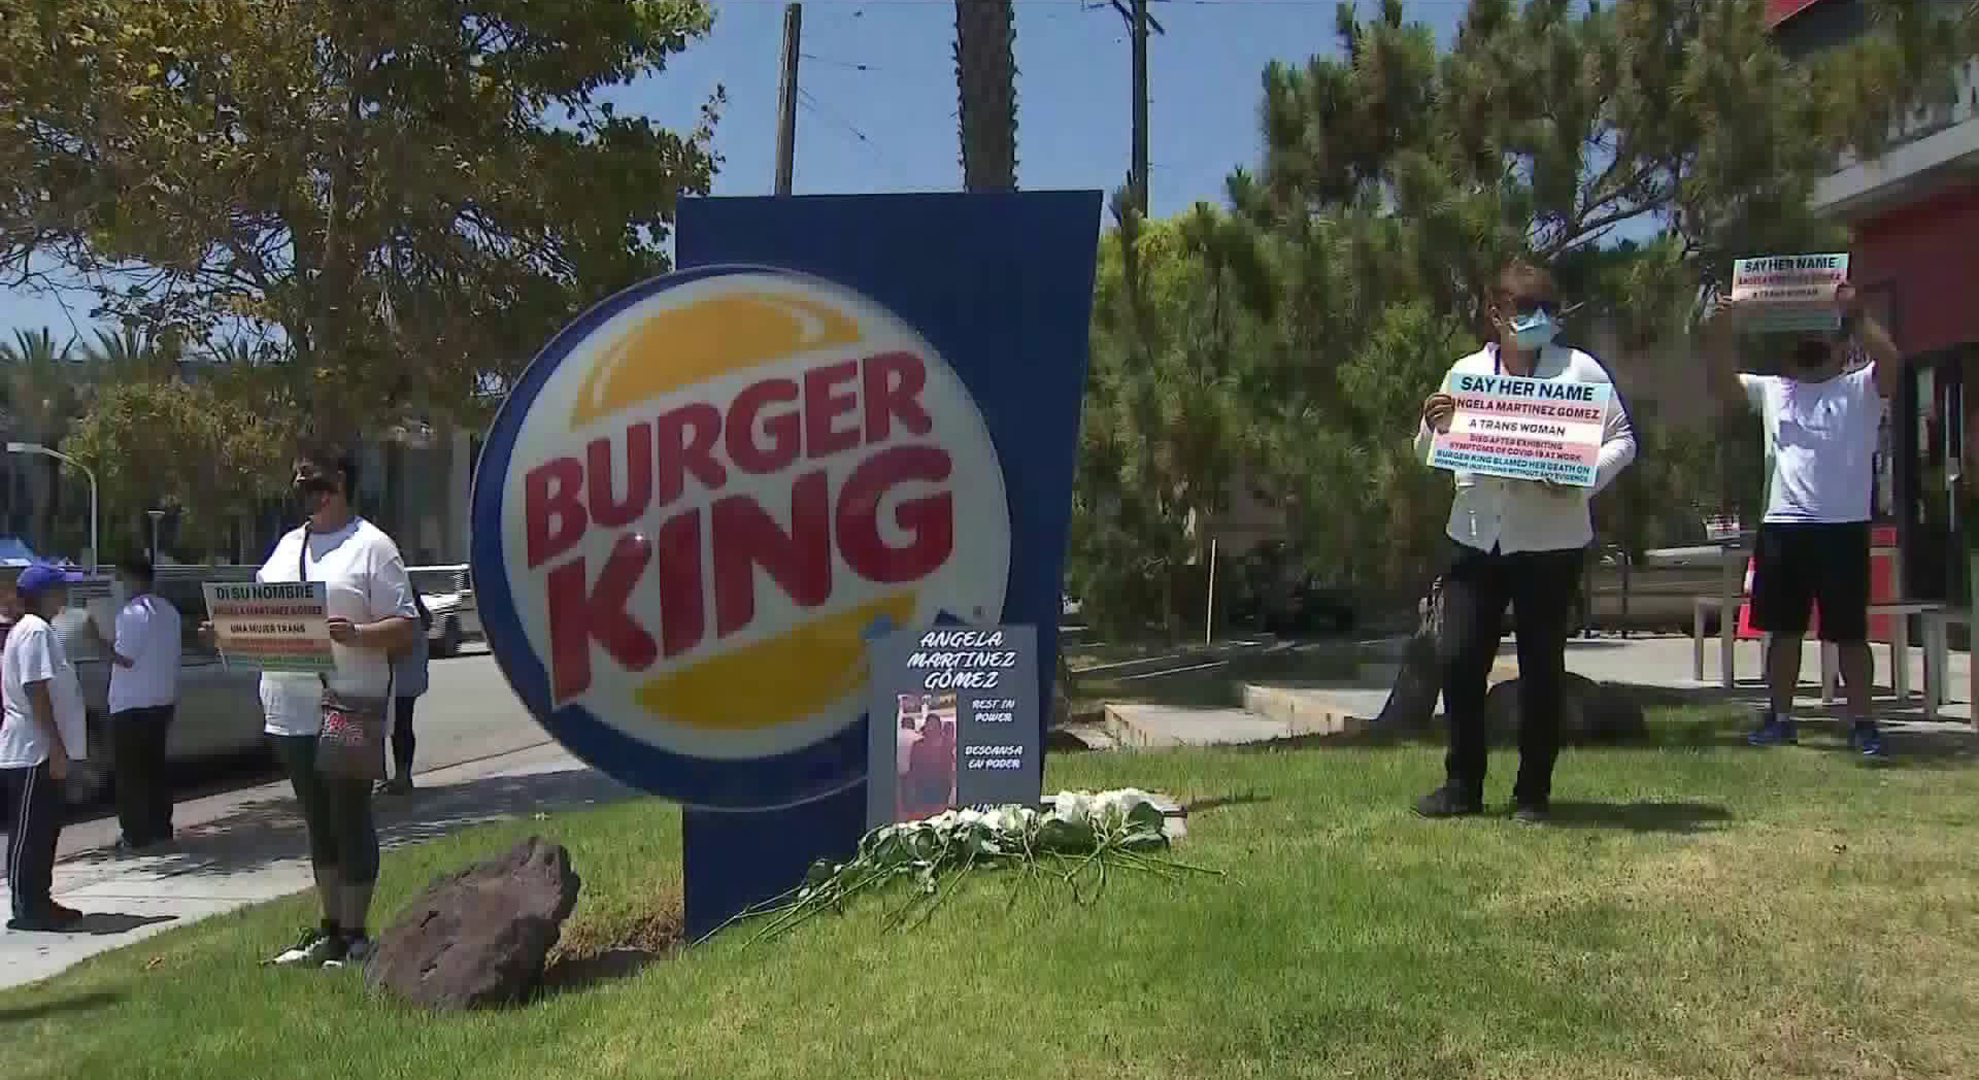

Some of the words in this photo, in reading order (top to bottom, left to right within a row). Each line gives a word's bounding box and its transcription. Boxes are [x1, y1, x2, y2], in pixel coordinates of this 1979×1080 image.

[1745, 260, 1767, 273] SAY
[1769, 259, 1794, 270] HER
[1797, 257, 1836, 269] NAME
[1460, 377, 1496, 393] SAY
[1499, 380, 1535, 397] HER
[1538, 383, 1594, 401] NAME
[1496, 401, 1555, 416] MARTINEZ
[1557, 406, 1600, 420] GOMEZ
[1469, 419, 1477, 428] A
[1480, 420, 1518, 432] TRANS
[1521, 423, 1566, 436] WOMAN
[525, 350, 932, 569] BURGER
[1450, 442, 1494, 453] SYMPTOMS
[1557, 452, 1582, 462] WORK
[1437, 449, 1470, 461] BURGER
[1471, 453, 1492, 464] KING
[1577, 465, 1591, 475] ON
[547, 444, 953, 705] KING
[215, 586, 230, 599] DI
[231, 586, 248, 599] SU
[251, 584, 314, 599] NOMBRE
[277, 623, 306, 633] TRANS
[921, 630, 1003, 648] ANGELA
[906, 650, 1017, 668] MARTINEZ
[924, 668, 999, 690] GÓMEZ
[972, 699, 1000, 710] REST
[1001, 699, 1016, 710] IN
[975, 712, 1013, 722] POWER
[964, 745, 1023, 756] DESCANSA
[968, 759, 984, 769] EN
[986, 759, 1021, 769] PODER
